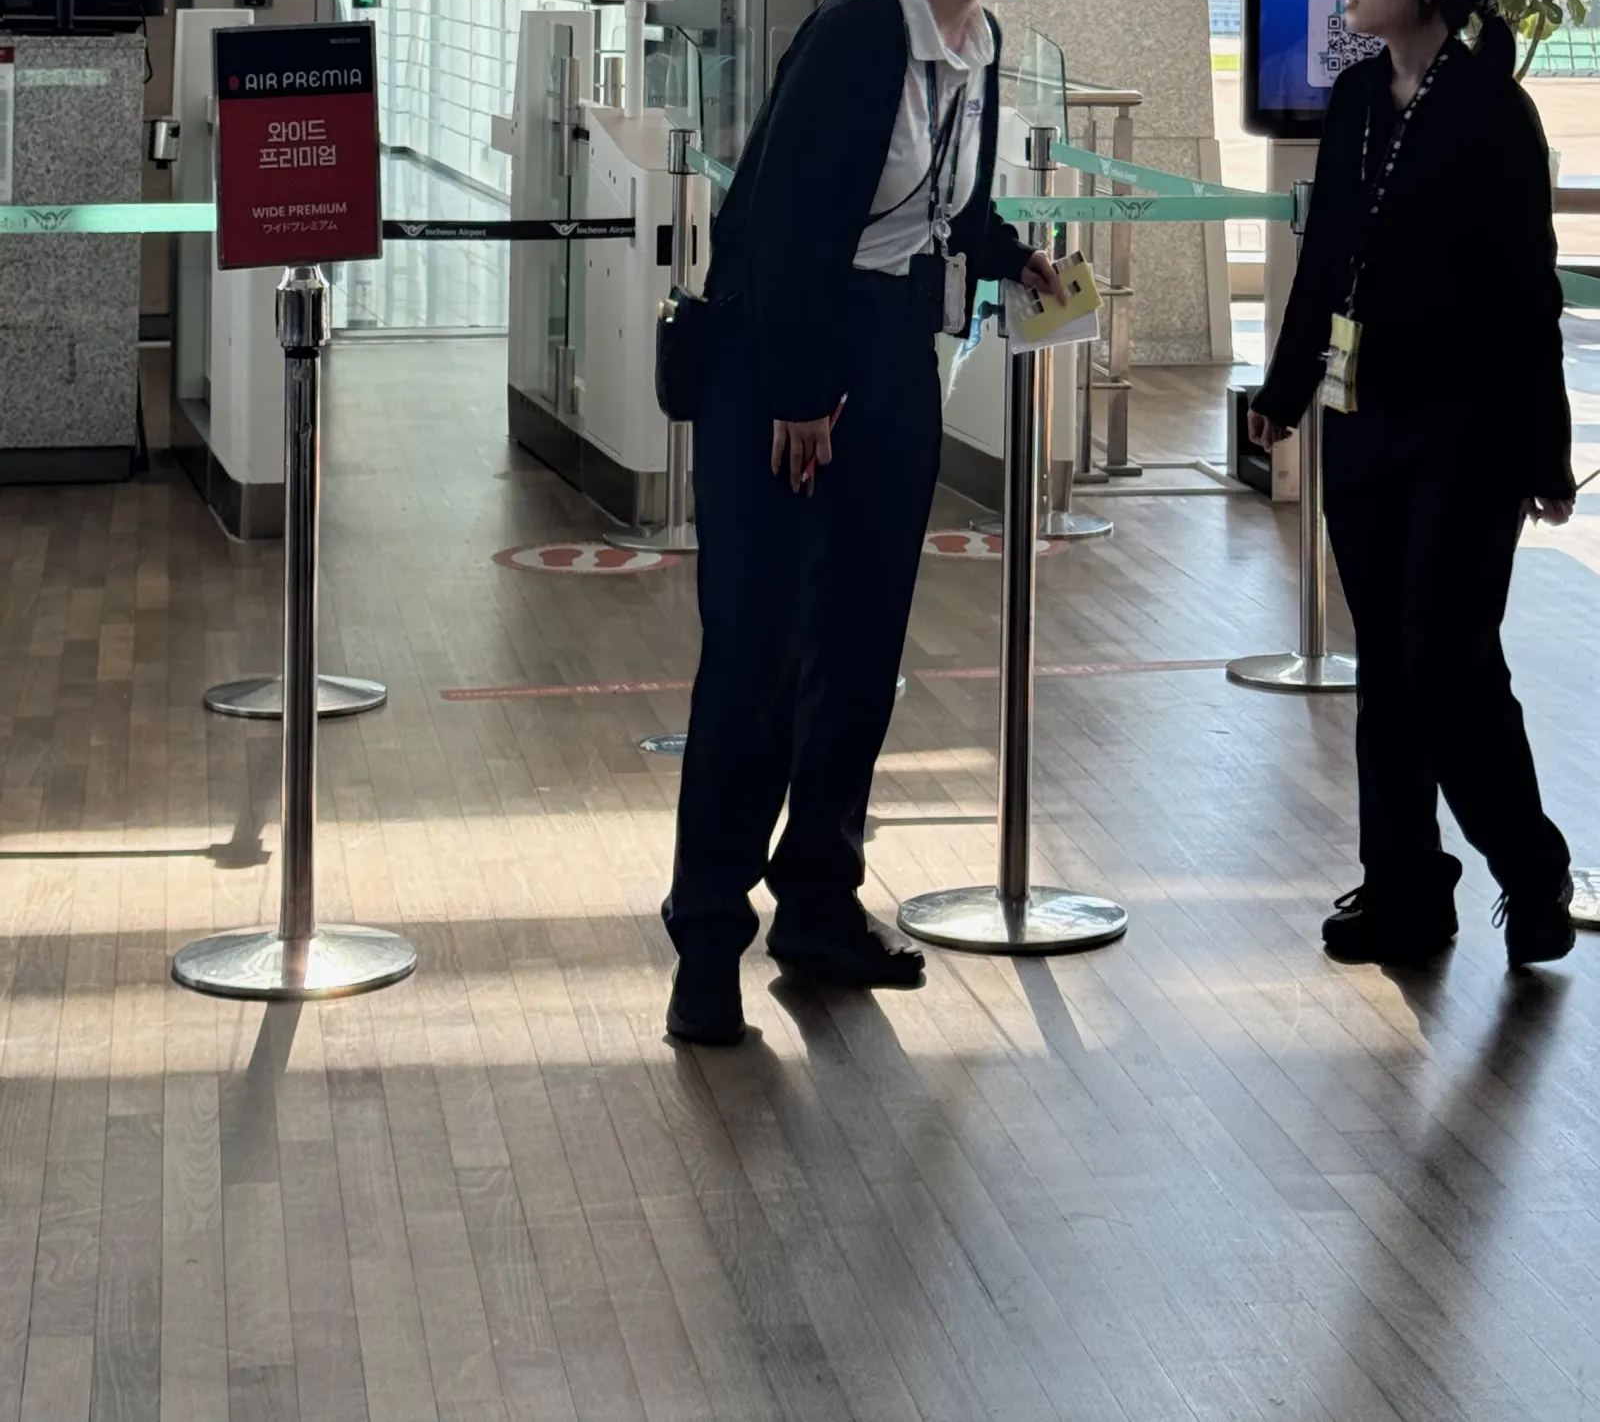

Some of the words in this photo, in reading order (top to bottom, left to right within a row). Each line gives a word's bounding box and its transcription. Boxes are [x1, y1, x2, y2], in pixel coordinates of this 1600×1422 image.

[245, 72, 278, 91] AIR
[282, 68, 362, 89] PREMIA
[267, 119, 327, 143] 와이드
[258, 144, 337, 169] 프리미엄
[252, 205, 286, 219] WIDE
[288, 201, 347, 217] PREMIUM
[425, 228, 456, 237] Incheon
[458, 228, 487, 238] Airport
[576, 225, 608, 234] Incheon
